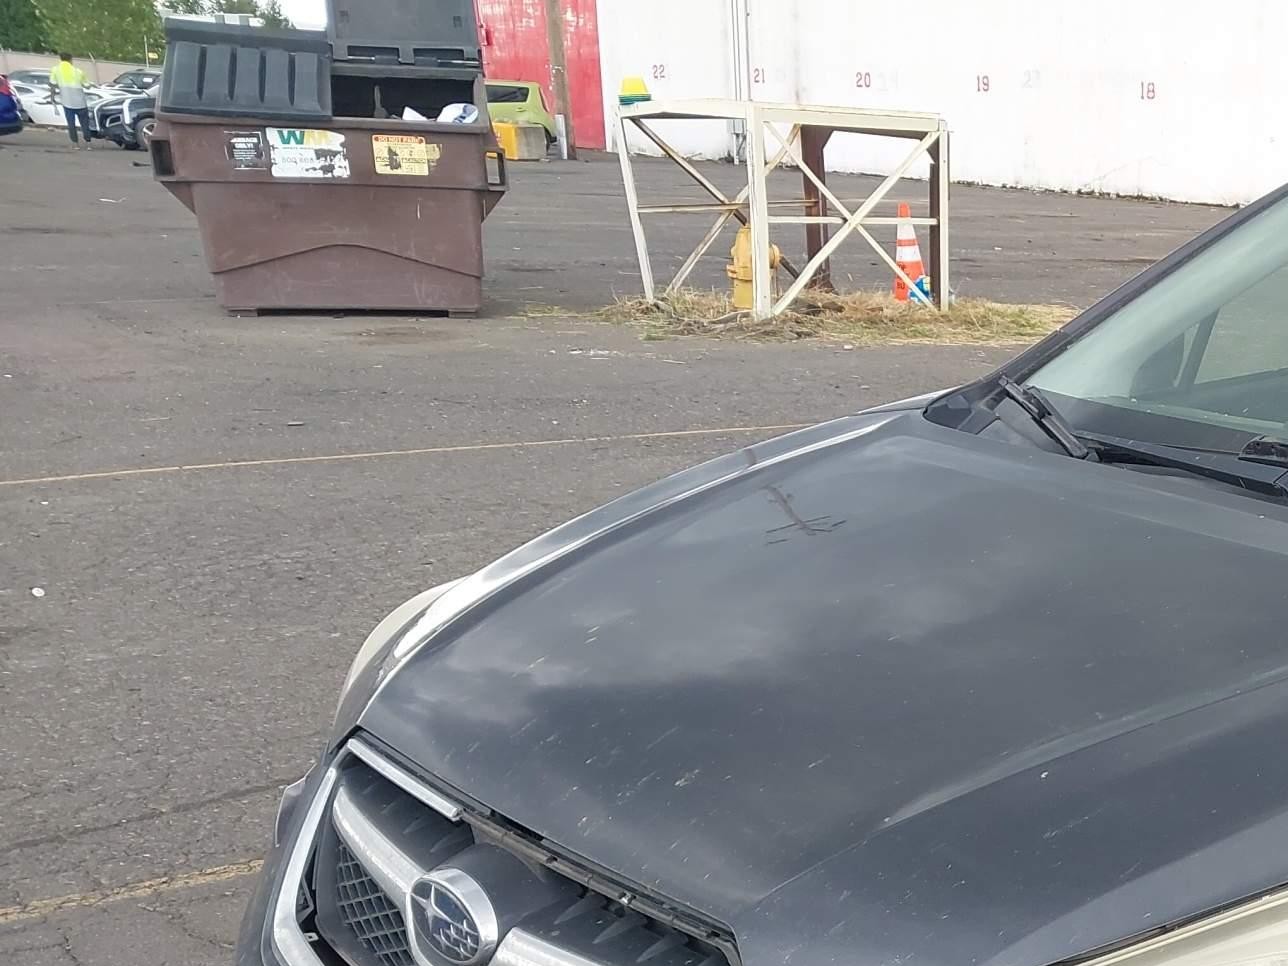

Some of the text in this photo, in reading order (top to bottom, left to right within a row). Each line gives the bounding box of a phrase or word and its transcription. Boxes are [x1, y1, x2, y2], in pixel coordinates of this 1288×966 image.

[652, 64, 666, 79] 22
[753, 68, 766, 84] 21
[856, 72, 872, 88] 20
[976, 75, 990, 92] 19
[1140, 81, 1156, 100] 18
